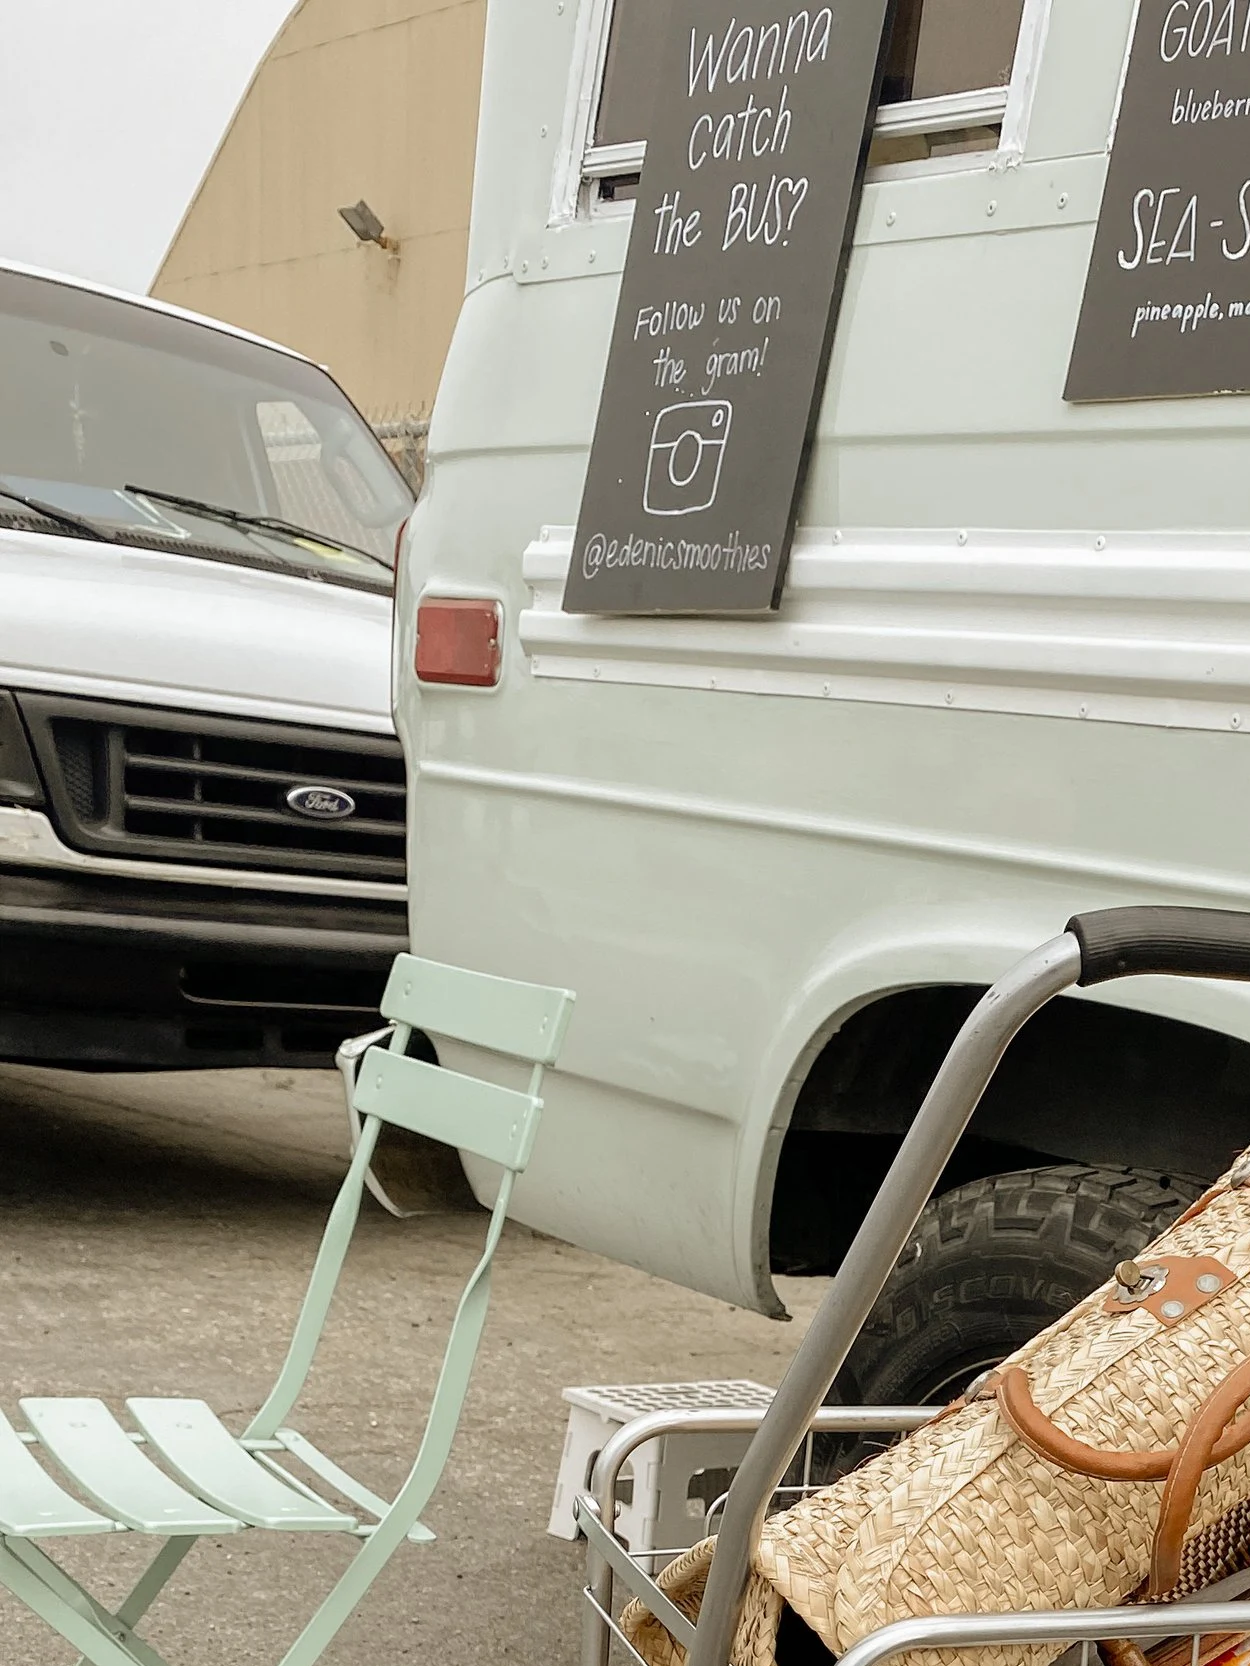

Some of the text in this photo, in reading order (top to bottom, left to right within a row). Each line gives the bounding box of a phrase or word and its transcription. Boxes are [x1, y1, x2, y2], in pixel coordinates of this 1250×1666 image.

[687, 6, 833, 98] Wanna
[688, 84, 793, 171] catch
[653, 173, 809, 255] the BUS?
[632, 294, 782, 342] Follow us on
[1130, 291, 1225, 339] pineapple,
[653, 345, 687, 388] the
[582, 530, 772, 581] @edenicsmoothies
[304, 791, 341, 812] Ford
